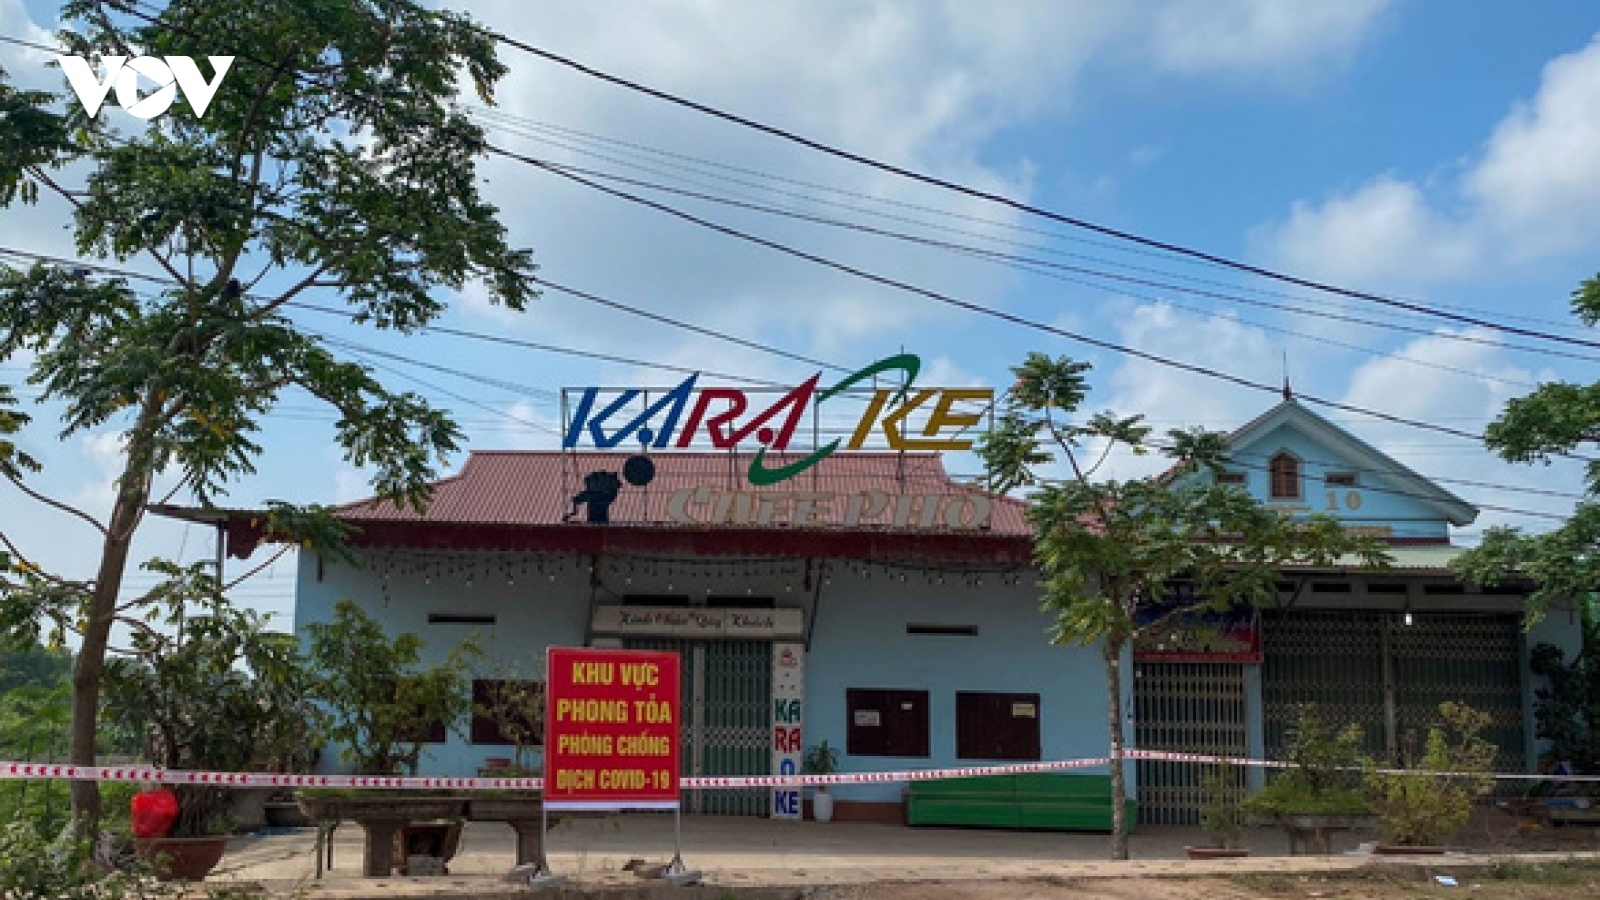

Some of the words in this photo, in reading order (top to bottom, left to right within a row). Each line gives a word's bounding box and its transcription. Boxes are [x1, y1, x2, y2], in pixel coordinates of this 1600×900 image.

[1325, 490, 1363, 511] 10
[572, 661, 614, 685] KHU
[619, 661, 659, 691] VỰC
[556, 698, 628, 723] PHONG
[616, 728, 670, 757] CHỐNG
[599, 768, 670, 790] COVID-19
